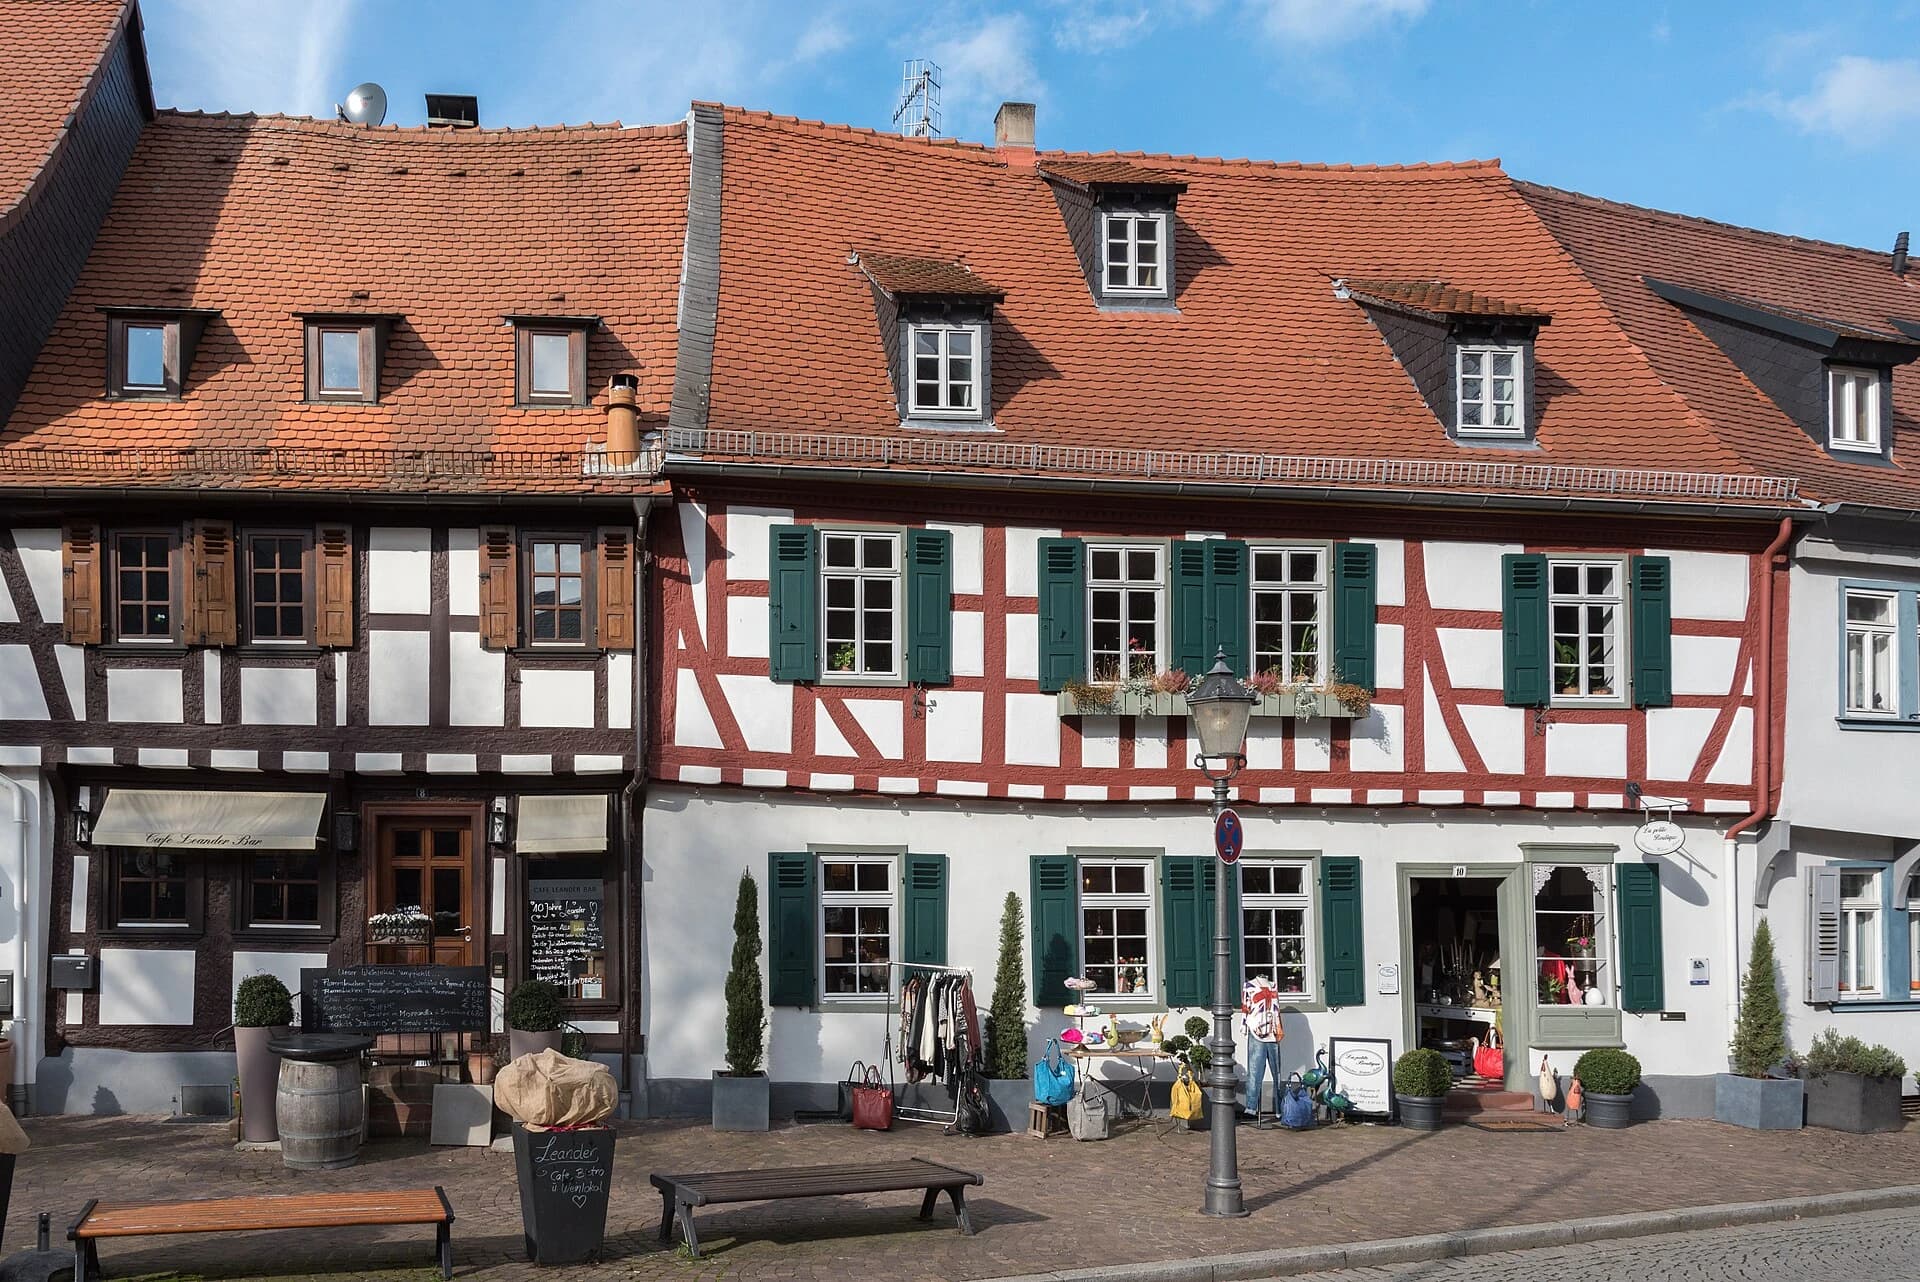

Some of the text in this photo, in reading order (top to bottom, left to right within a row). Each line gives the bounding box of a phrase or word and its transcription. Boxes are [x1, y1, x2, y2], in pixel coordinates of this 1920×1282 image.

[419, 788, 425, 798] 8
[177, 833, 229, 846] Leander
[232, 834, 262, 846] Bar
[1456, 867, 1464, 876] 10
[535, 1136, 598, 1162] Leander
[561, 1180, 603, 1193] Weinlokal
